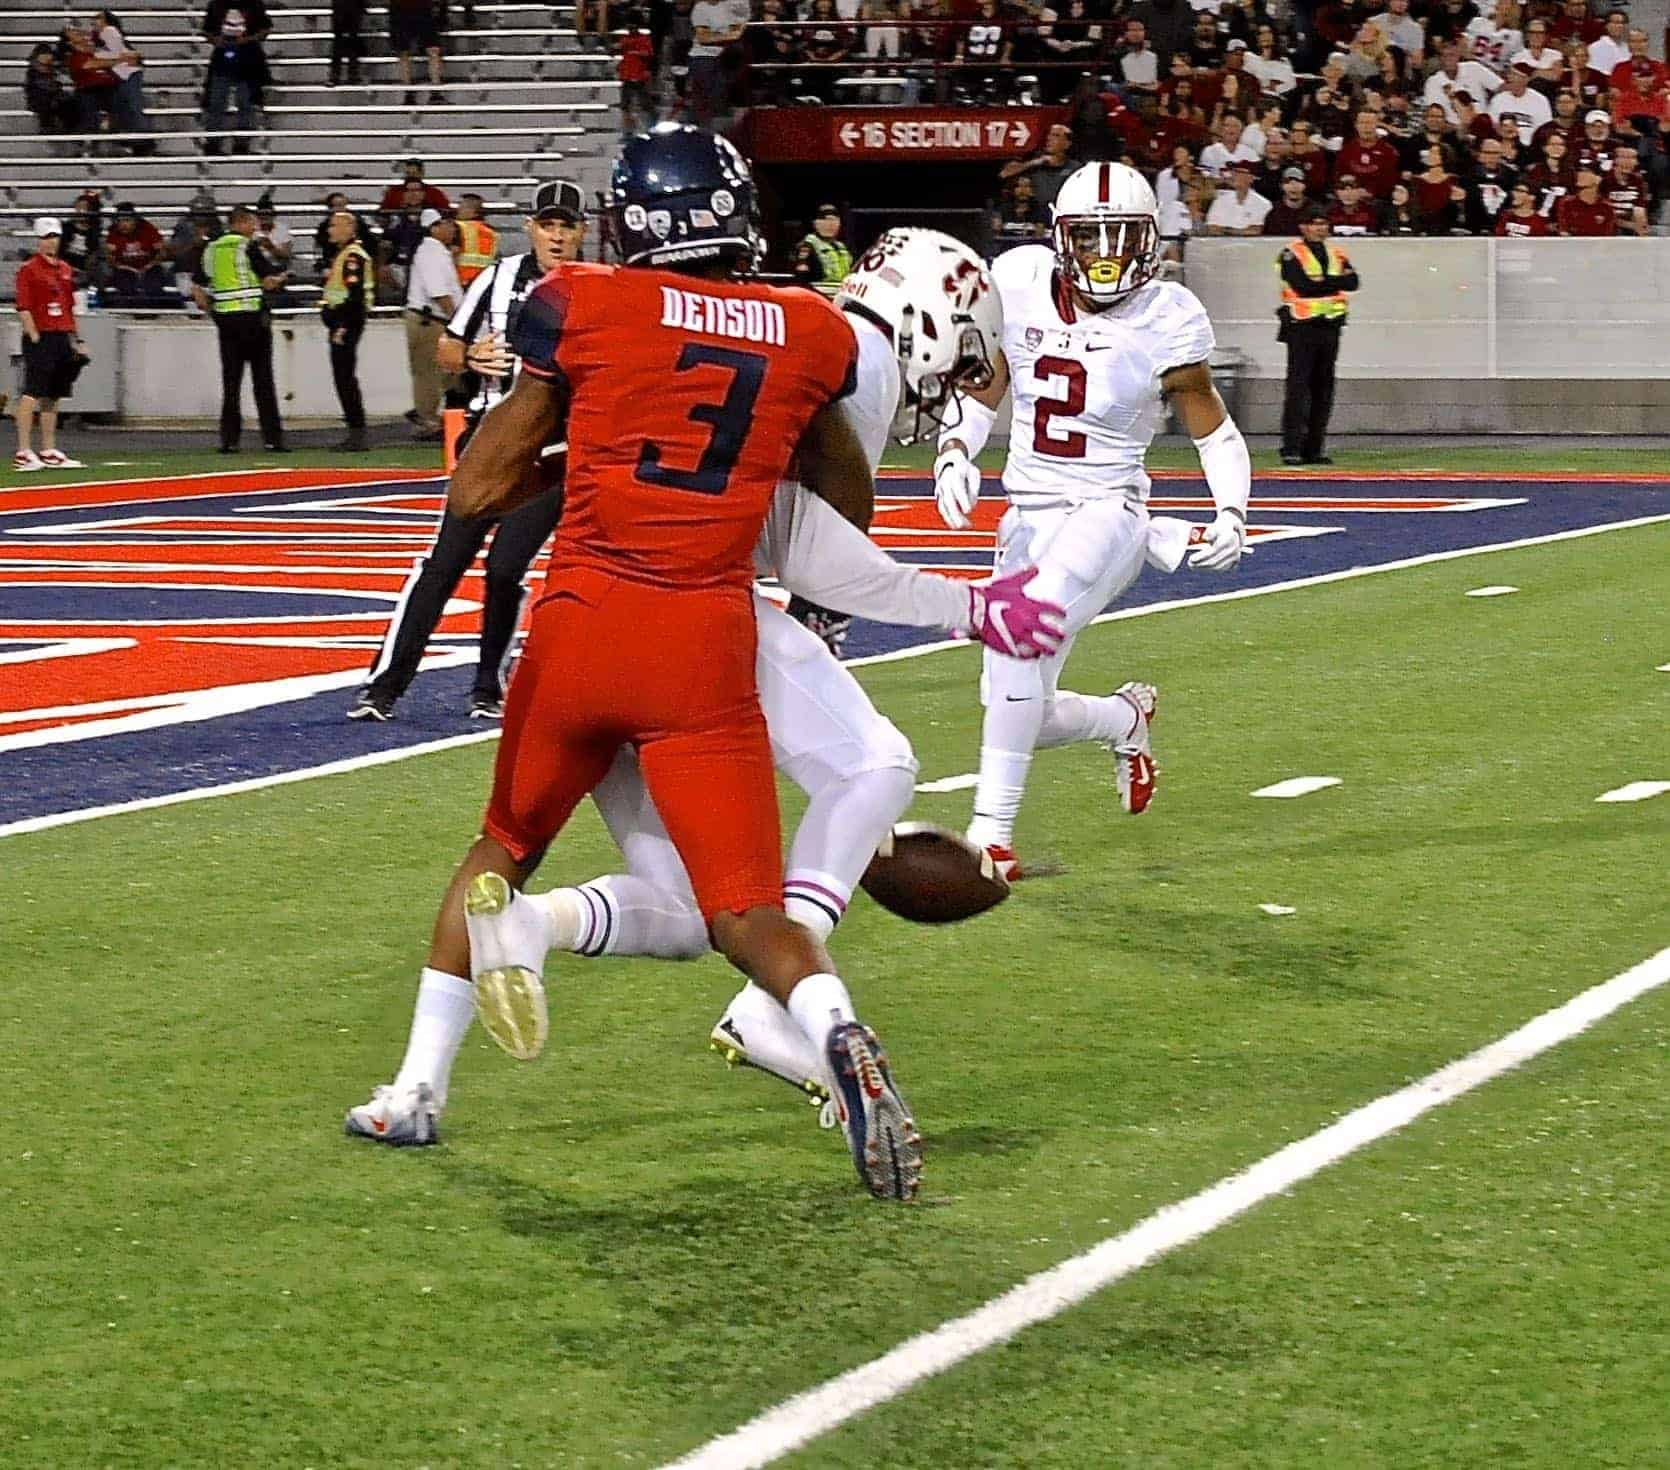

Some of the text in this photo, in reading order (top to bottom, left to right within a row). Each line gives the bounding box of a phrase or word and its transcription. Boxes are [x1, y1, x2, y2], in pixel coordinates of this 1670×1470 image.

[861, 121, 1008, 148] 16 SECTION 17
[660, 286, 786, 346] DENSON
[634, 341, 769, 495] 3
[1033, 354, 1088, 458] 2
